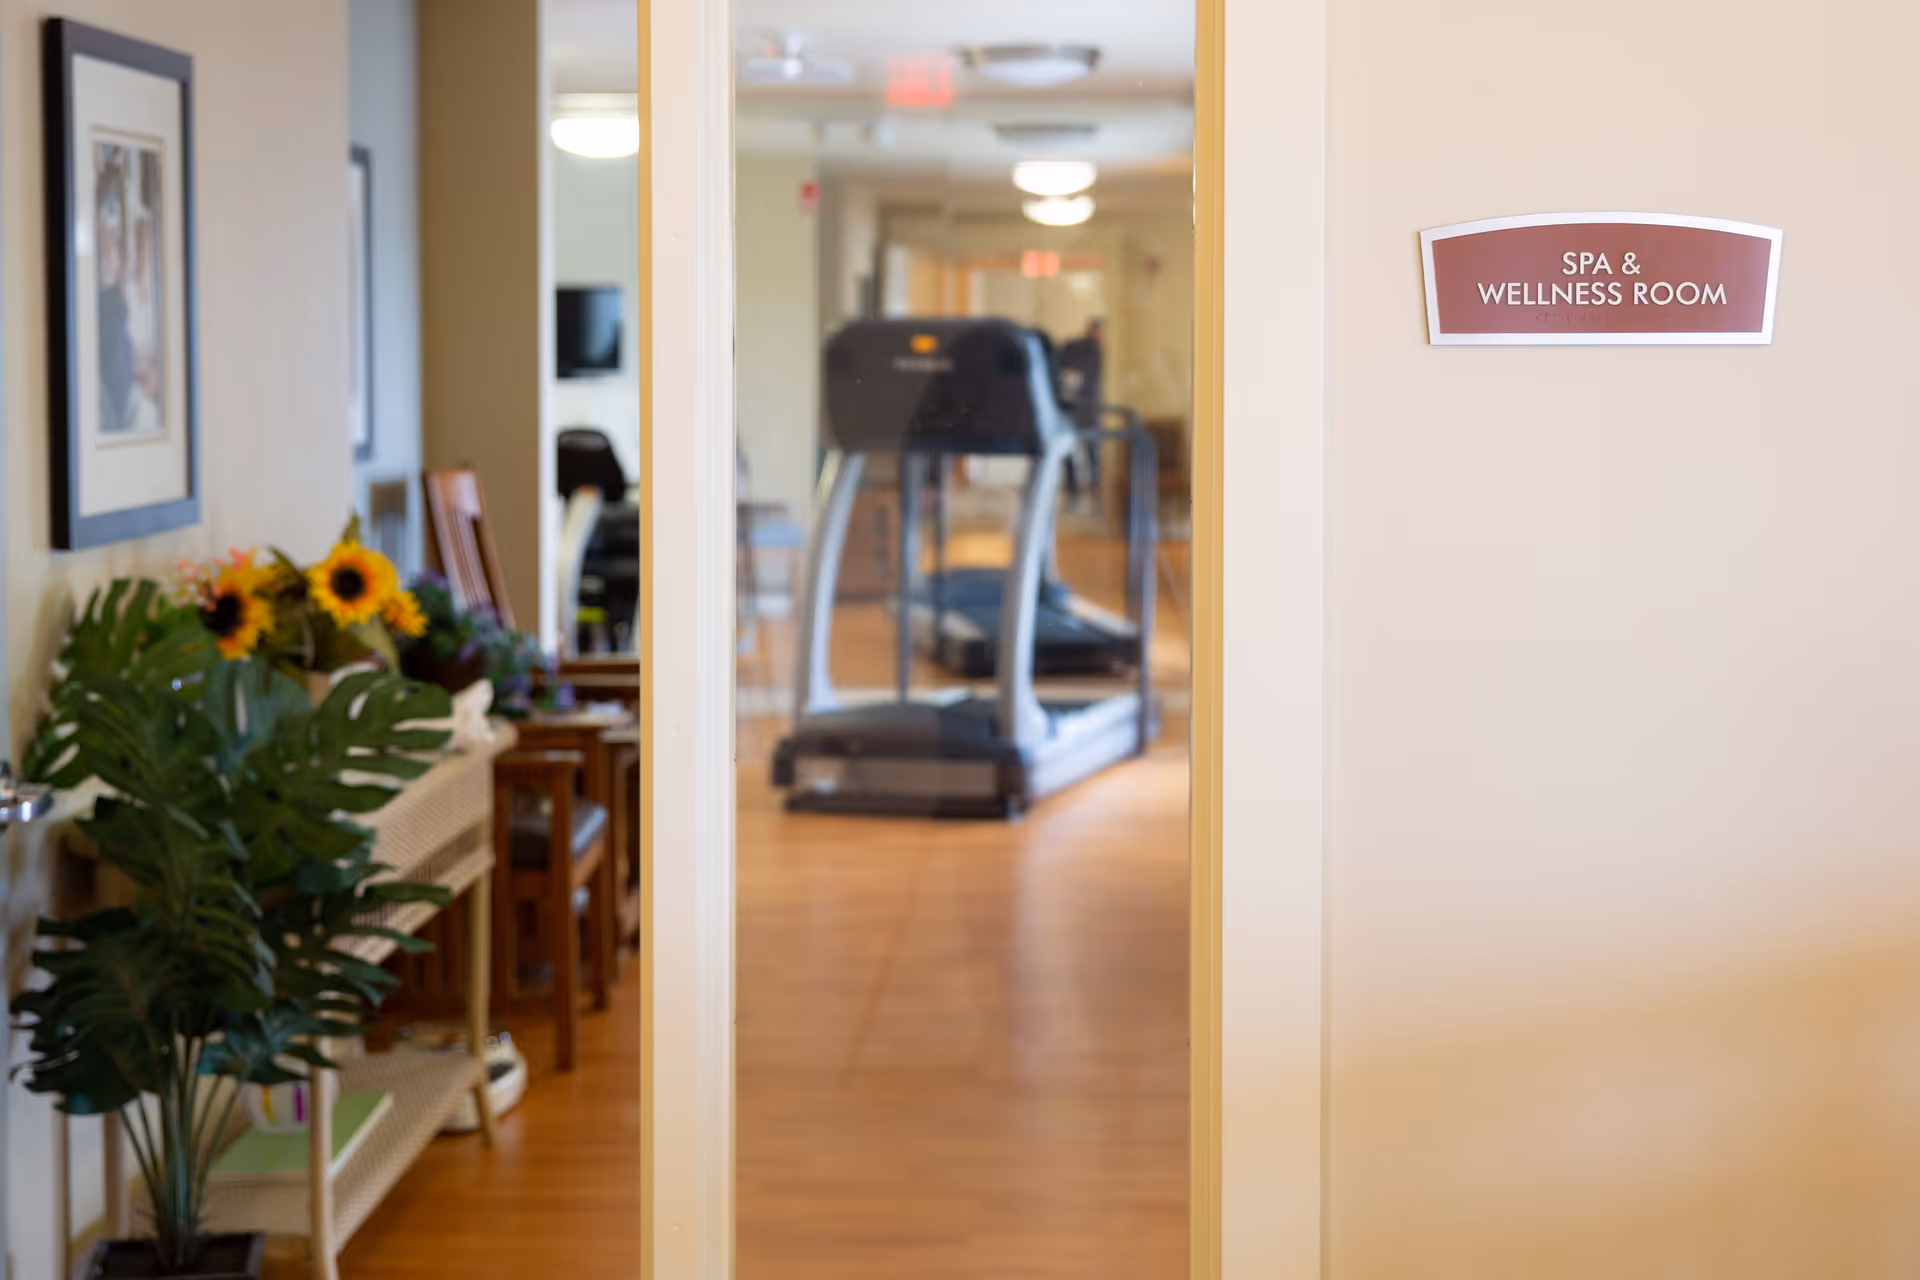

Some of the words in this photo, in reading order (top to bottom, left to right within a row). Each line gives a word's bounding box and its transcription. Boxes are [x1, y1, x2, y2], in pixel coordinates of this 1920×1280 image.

[1561, 251, 1613, 275] SPA
[1621, 251, 1641, 275] &
[1477, 281, 1623, 306] WELLNESS
[1633, 281, 1727, 306] ROOM
